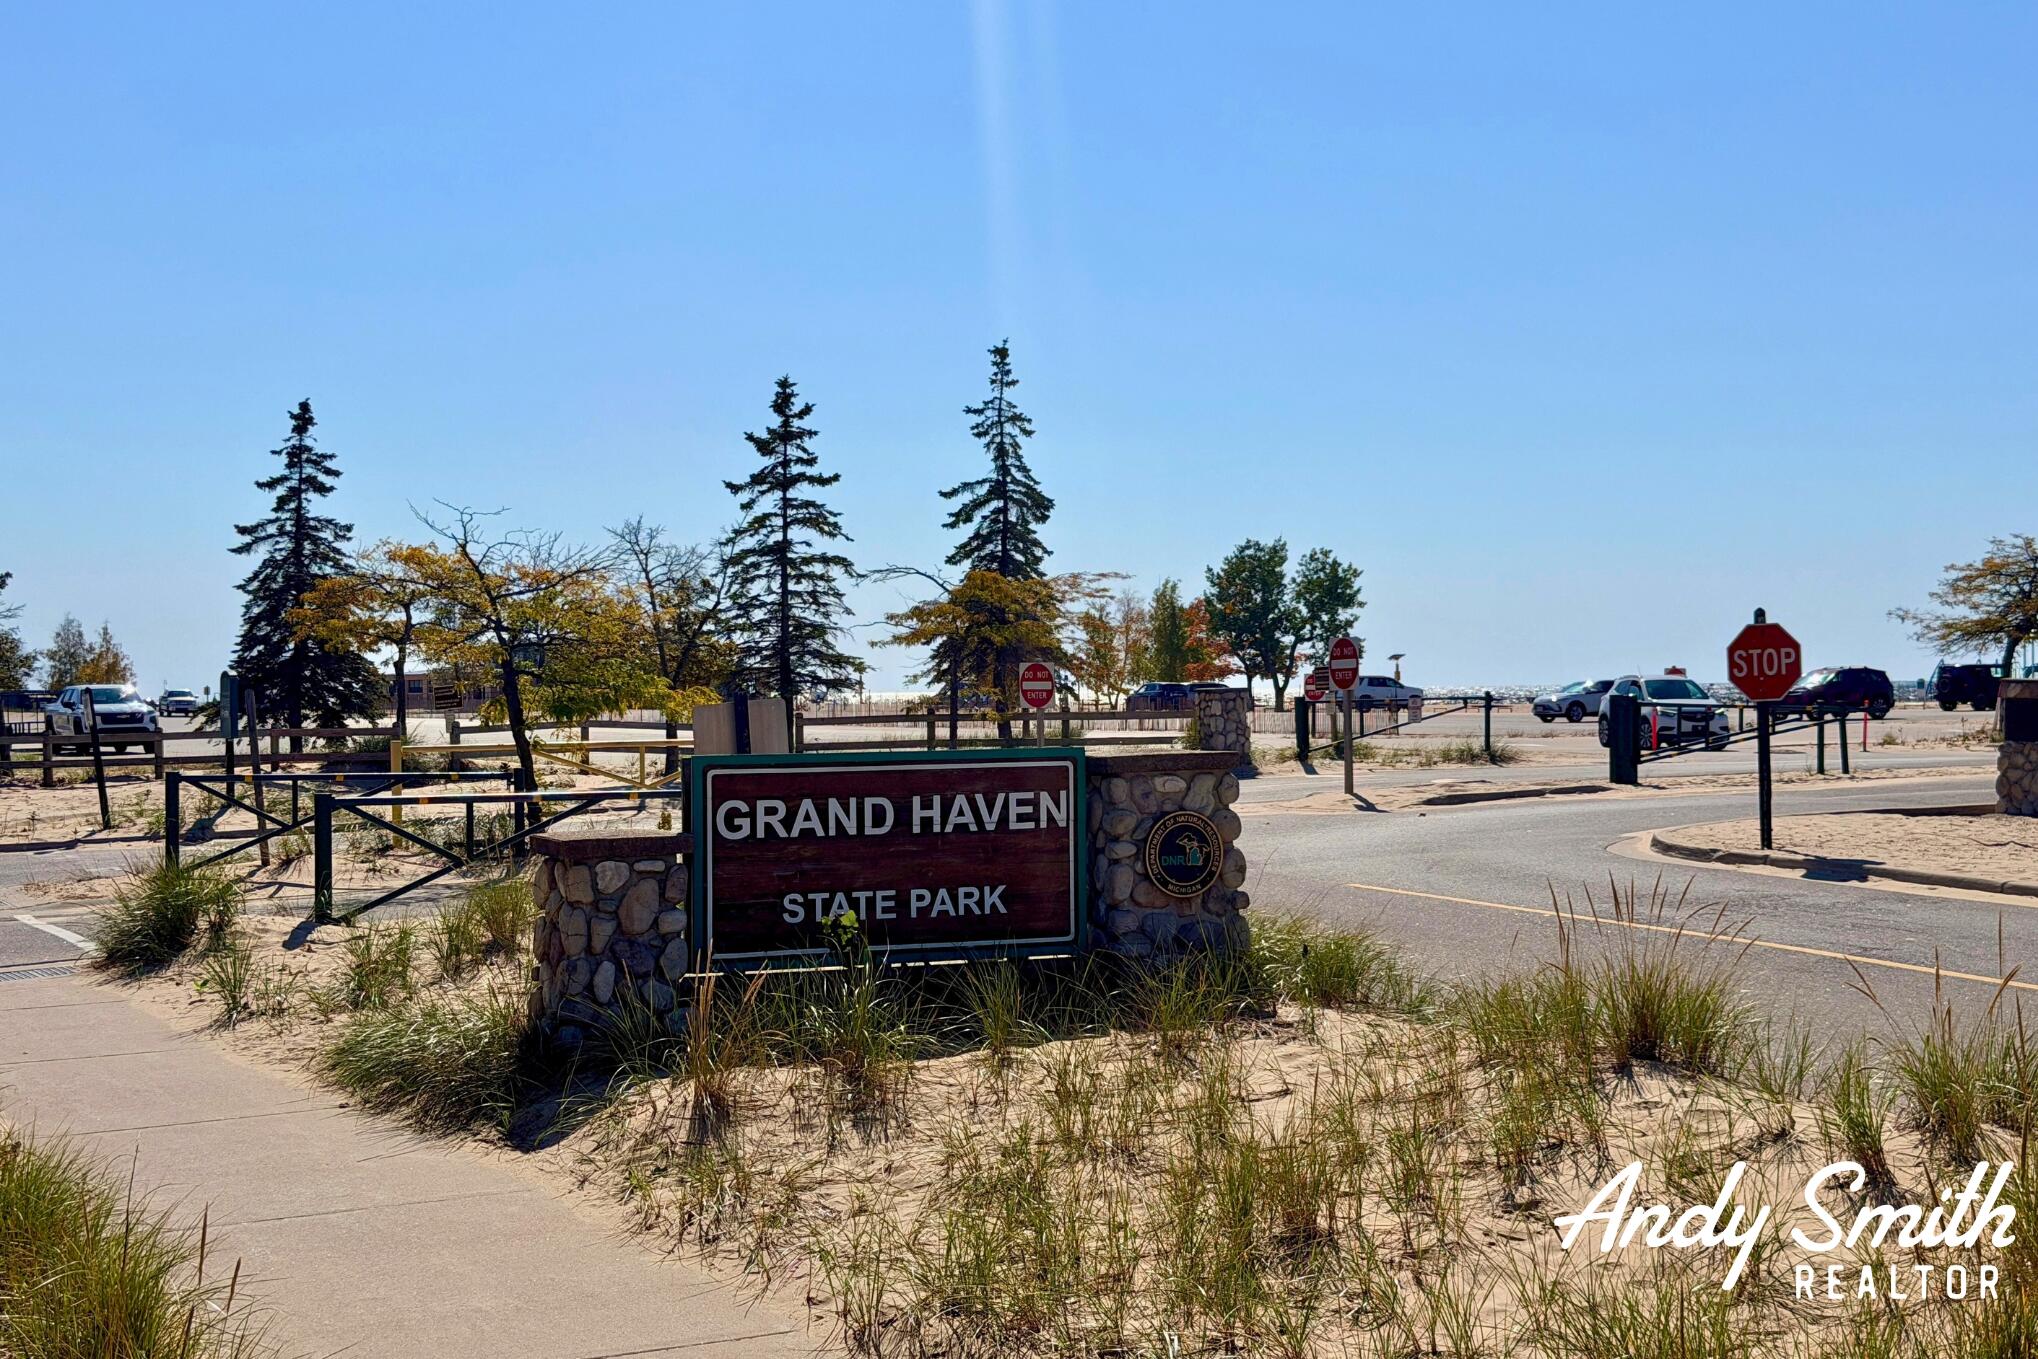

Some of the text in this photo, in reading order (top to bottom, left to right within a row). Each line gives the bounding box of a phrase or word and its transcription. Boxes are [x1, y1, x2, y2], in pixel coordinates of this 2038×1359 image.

[1332, 647, 1354, 656] DO NOT
[1732, 647, 1796, 678] STOP
[1335, 671, 1353, 680] ENTER
[1027, 691, 1047, 699] ENTER
[715, 789, 1068, 841] GRAND HAVEN
[1150, 816, 1220, 874] DEPARTMENT OF NATURAL RESOURCES
[1161, 855, 1185, 866] DNR
[1167, 883, 1202, 893] MICHIGAN
[782, 884, 1008, 924] STATE PARK
